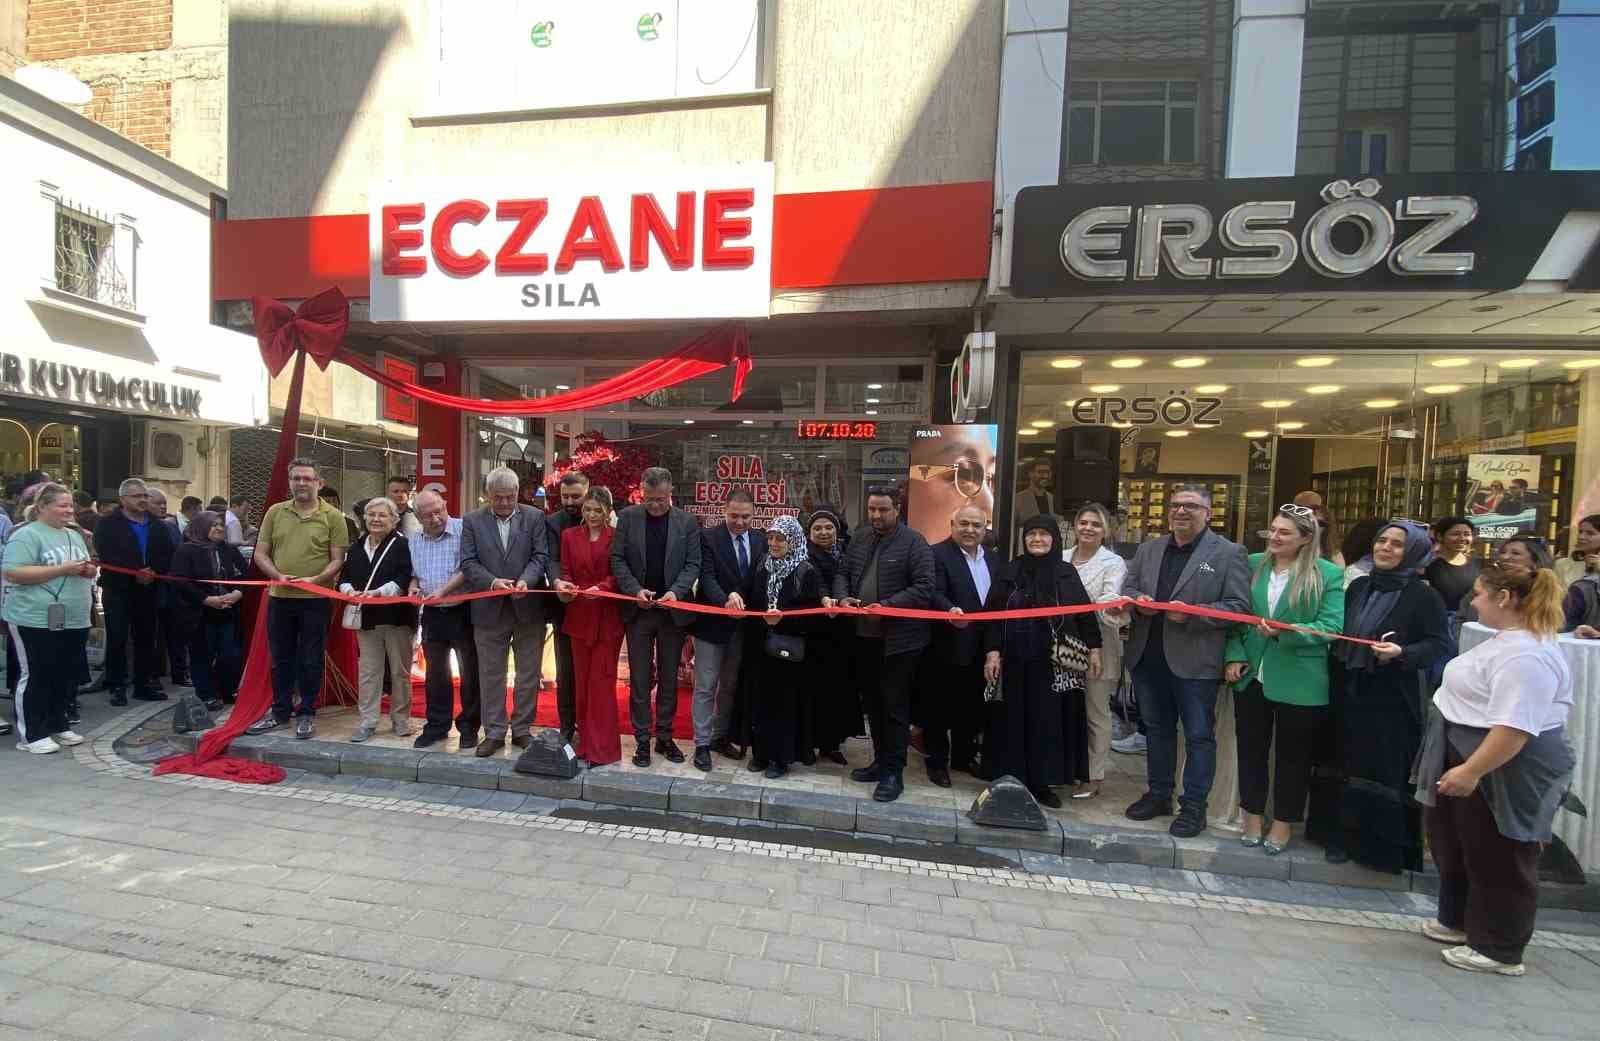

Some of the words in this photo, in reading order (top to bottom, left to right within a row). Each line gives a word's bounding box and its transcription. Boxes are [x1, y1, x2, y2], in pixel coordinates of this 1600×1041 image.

[381, 188, 755, 279] ECZANE
[1060, 179, 1478, 281] ERSÖZ
[521, 283, 601, 308] SILA
[0, 352, 26, 386] R
[29, 358, 202, 414] KUYUMCULUK
[1072, 389, 1222, 425] ERSÖZ
[916, 430, 942, 438] PRADA
[716, 455, 764, 480] SILA
